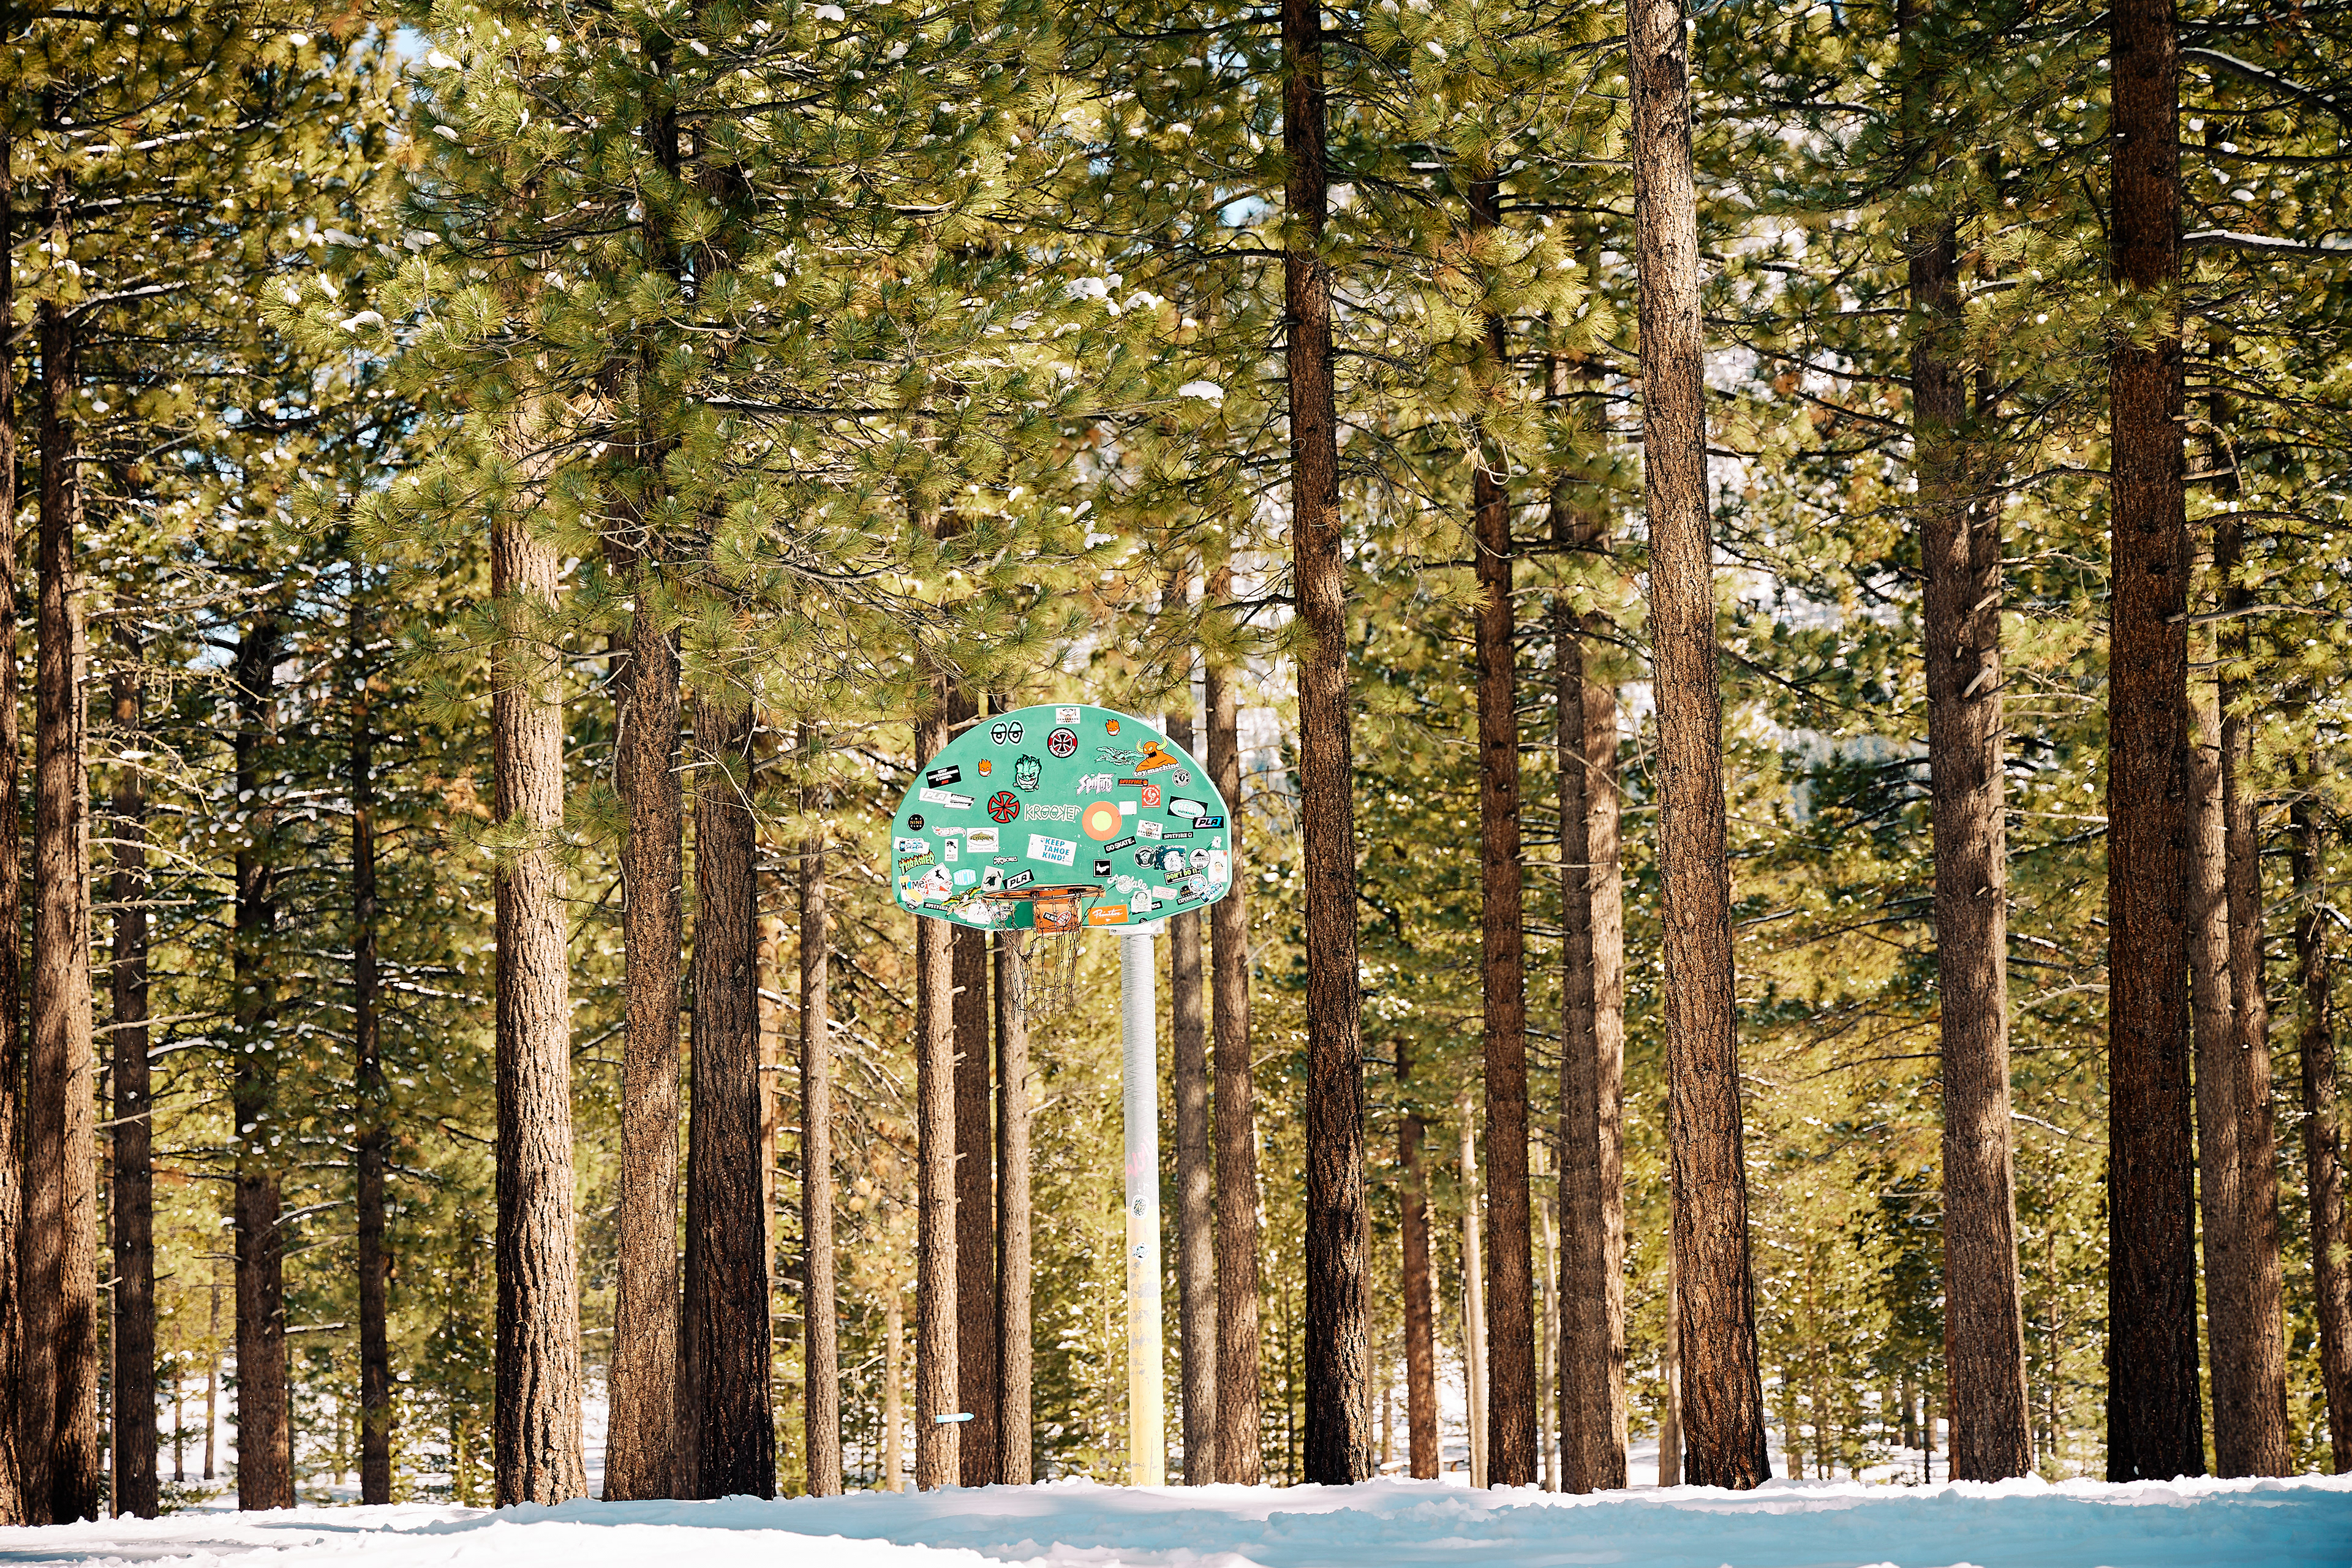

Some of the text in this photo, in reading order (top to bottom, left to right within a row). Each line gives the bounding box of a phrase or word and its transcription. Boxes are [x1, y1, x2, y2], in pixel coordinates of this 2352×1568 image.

[1147, 763, 1180, 774] machine
[924, 791, 947, 801] PLA
[1178, 802, 1198, 813] REAL
[1046, 838, 1065, 846] KEEP
[1114, 838, 1135, 849] SKATE.
[1044, 845, 1069, 856] TAHOE
[898, 850, 936, 875] THRASHER
[1042, 852, 1065, 862] KIND!
[956, 870, 975, 885] RICTA
[1009, 874, 1028, 887] PLA
[1167, 871, 1183, 880] DON'T
[1092, 908, 1123, 919] Primitive
